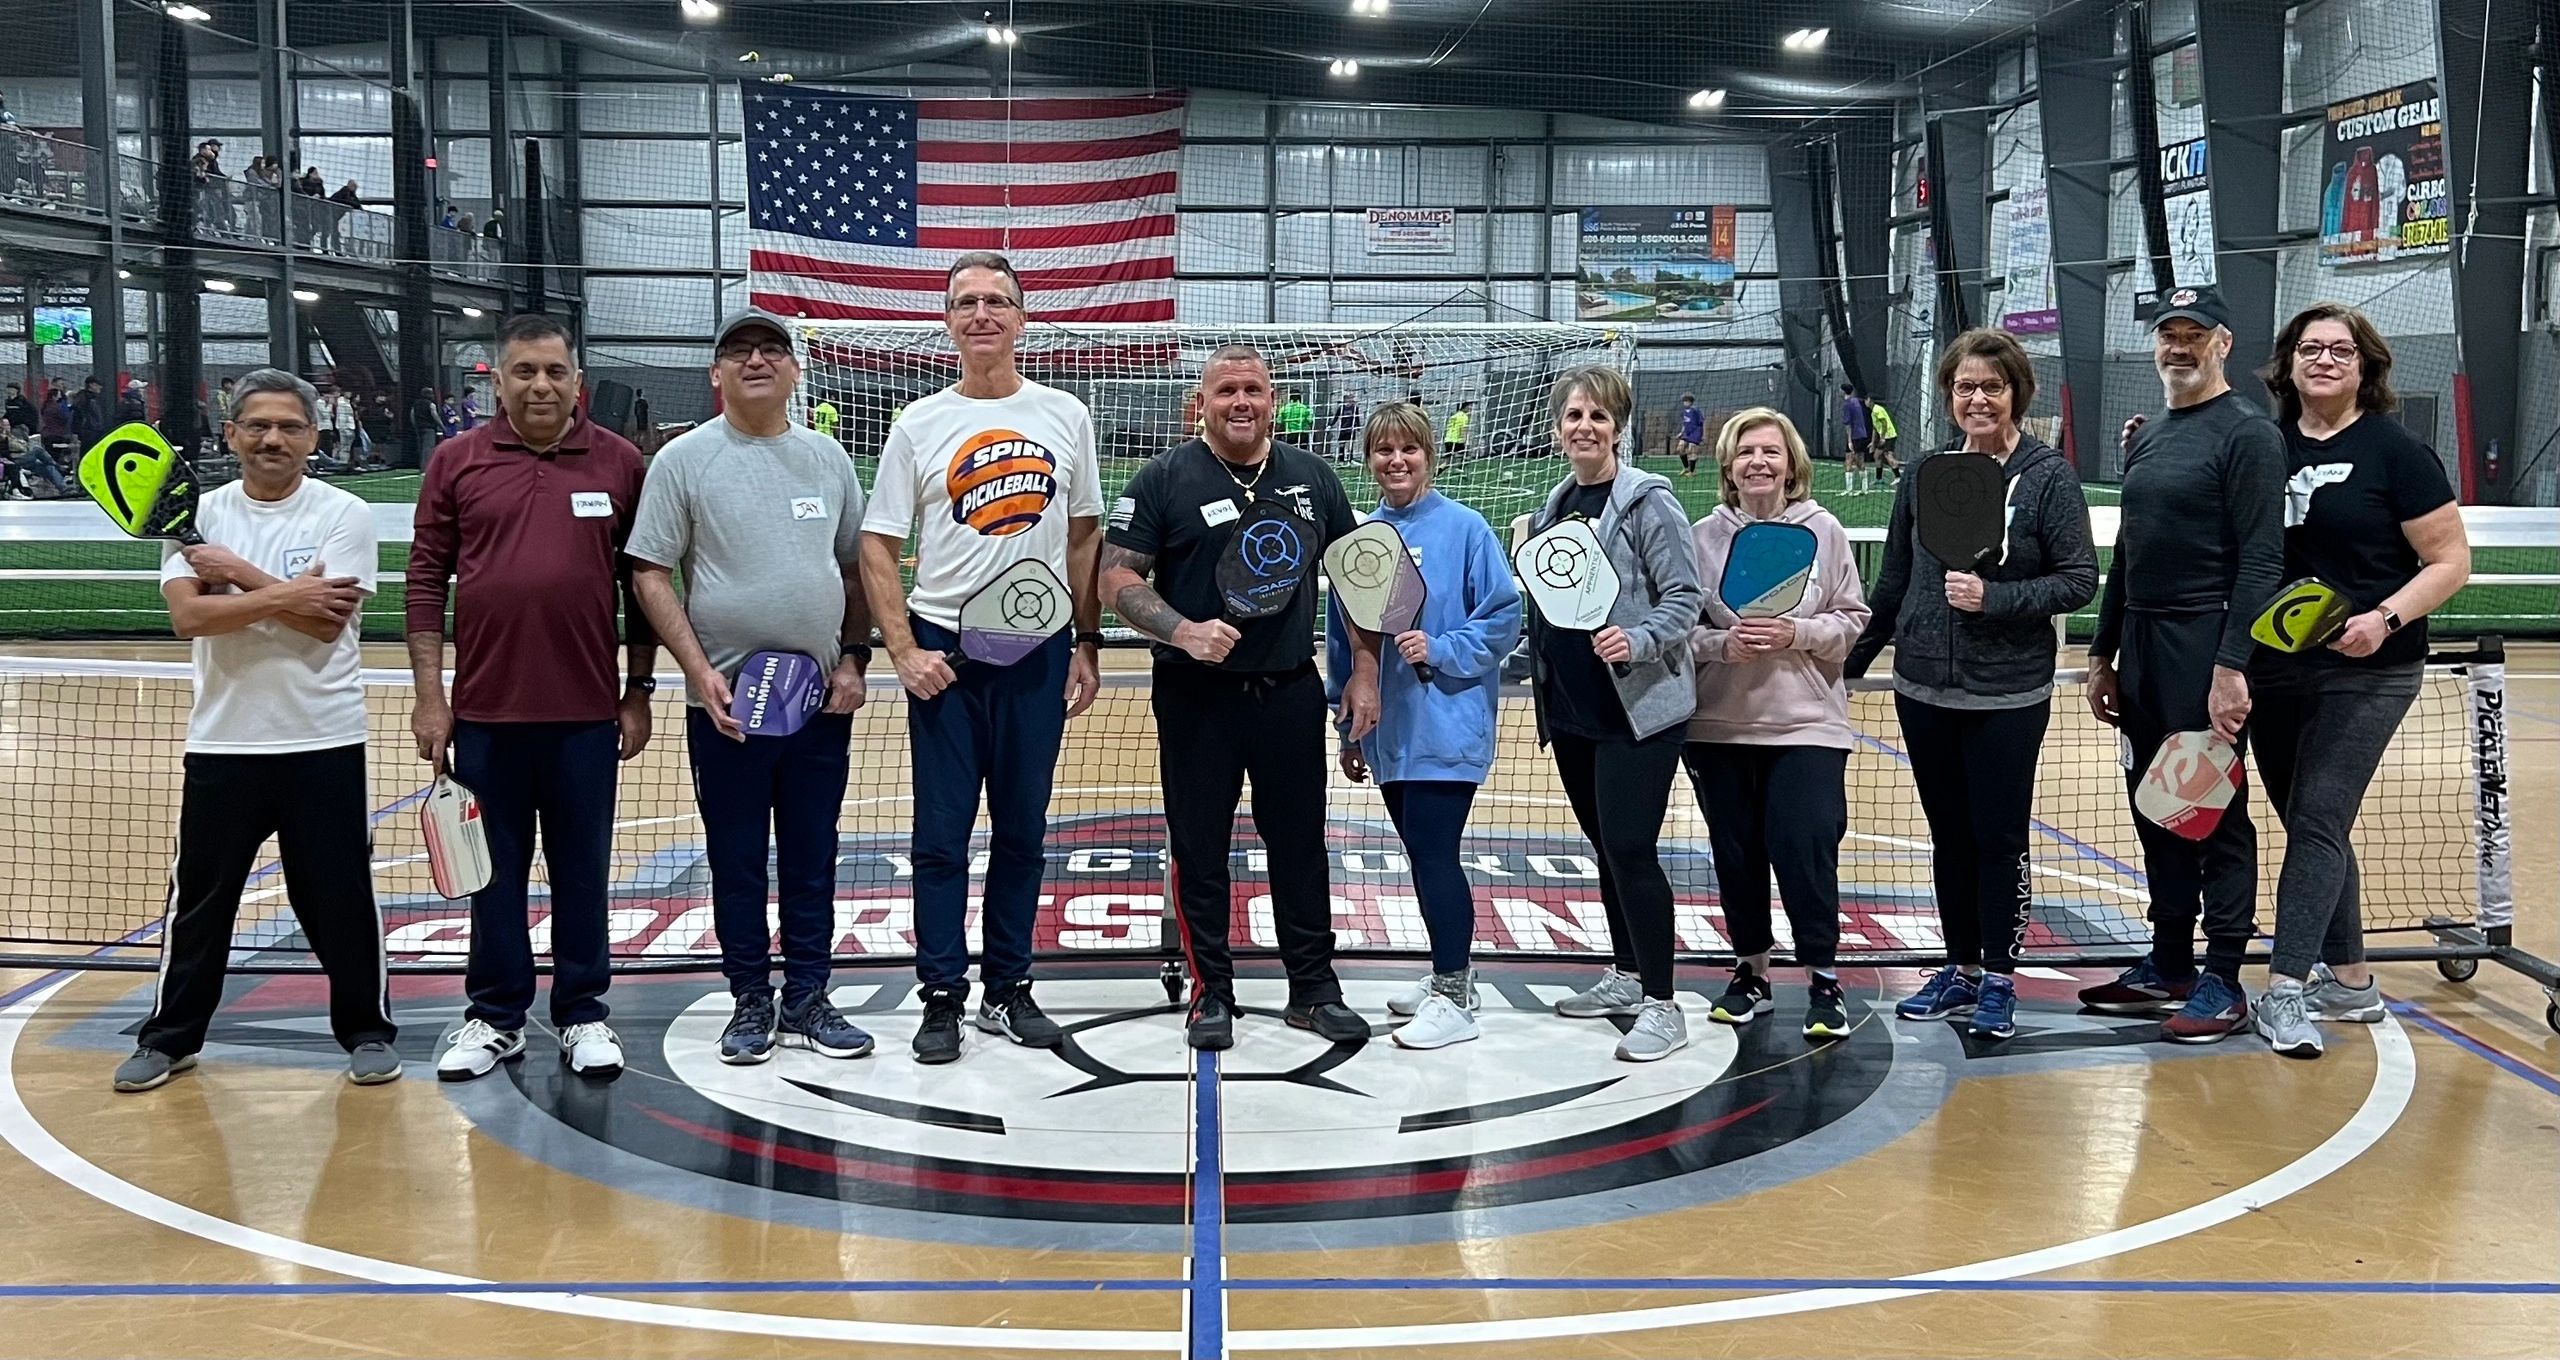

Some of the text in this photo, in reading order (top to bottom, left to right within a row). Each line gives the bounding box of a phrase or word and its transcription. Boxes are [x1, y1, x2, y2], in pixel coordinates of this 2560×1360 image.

[2337, 108, 2396, 141] CUSTOM
[1369, 211, 1451, 224] DENOMMEE
[973, 441, 1045, 469] SPIN
[961, 473, 1049, 519] PICKLEBALL
[1248, 575, 1300, 596] POACH
[1585, 550, 1601, 595] APPRENTICE
[1760, 572, 1807, 603] POACH
[748, 656, 779, 729] CHAMPION
[2016, 851, 2032, 899] Klein
[2008, 900, 2032, 960] Calvin
